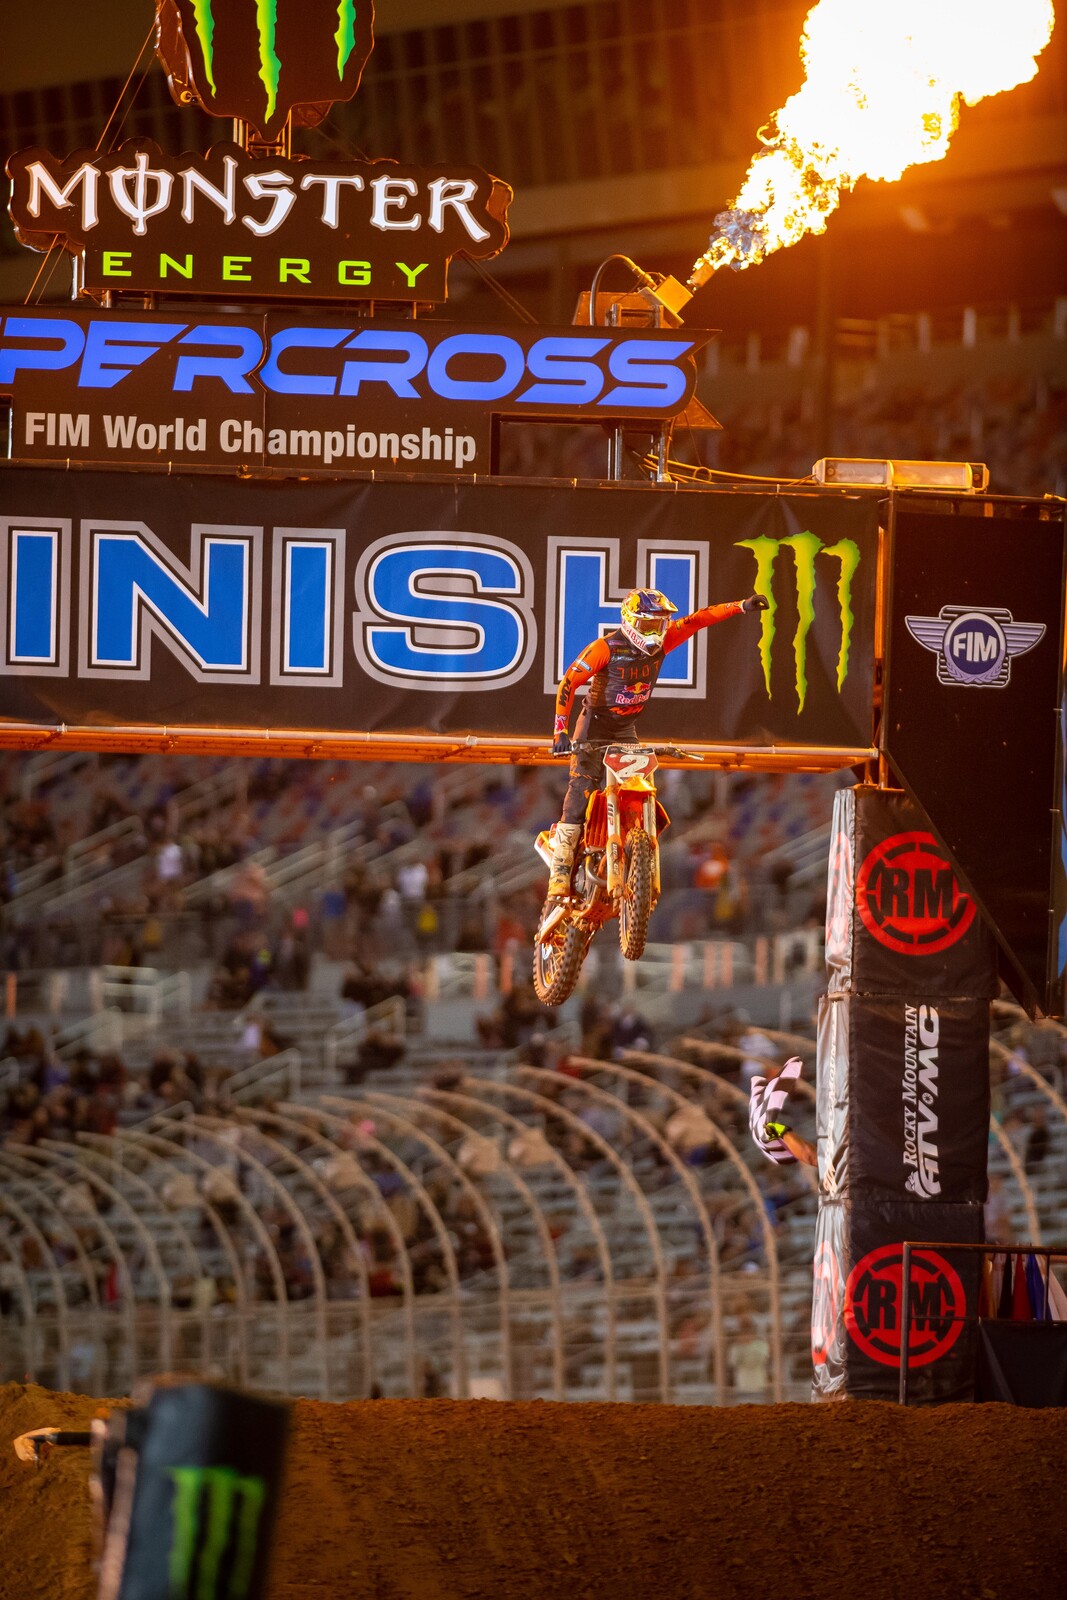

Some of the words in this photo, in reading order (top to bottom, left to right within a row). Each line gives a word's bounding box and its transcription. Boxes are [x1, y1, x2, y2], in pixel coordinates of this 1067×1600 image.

[25, 152, 491, 242] MONSTER
[102, 251, 430, 288] ENERGY
[0, 317, 696, 409] PERCROSS
[25, 412, 90, 447] FIM
[103, 414, 207, 453] World
[219, 418, 478, 469] Championship
[953, 631, 998, 662] FIM
[615, 754, 650, 779] 2
[881, 868, 954, 919] RM
[902, 1003, 918, 1105] MOUNTAIN
[903, 1110, 918, 1168] ROCKY
[868, 1279, 941, 1332] RM
